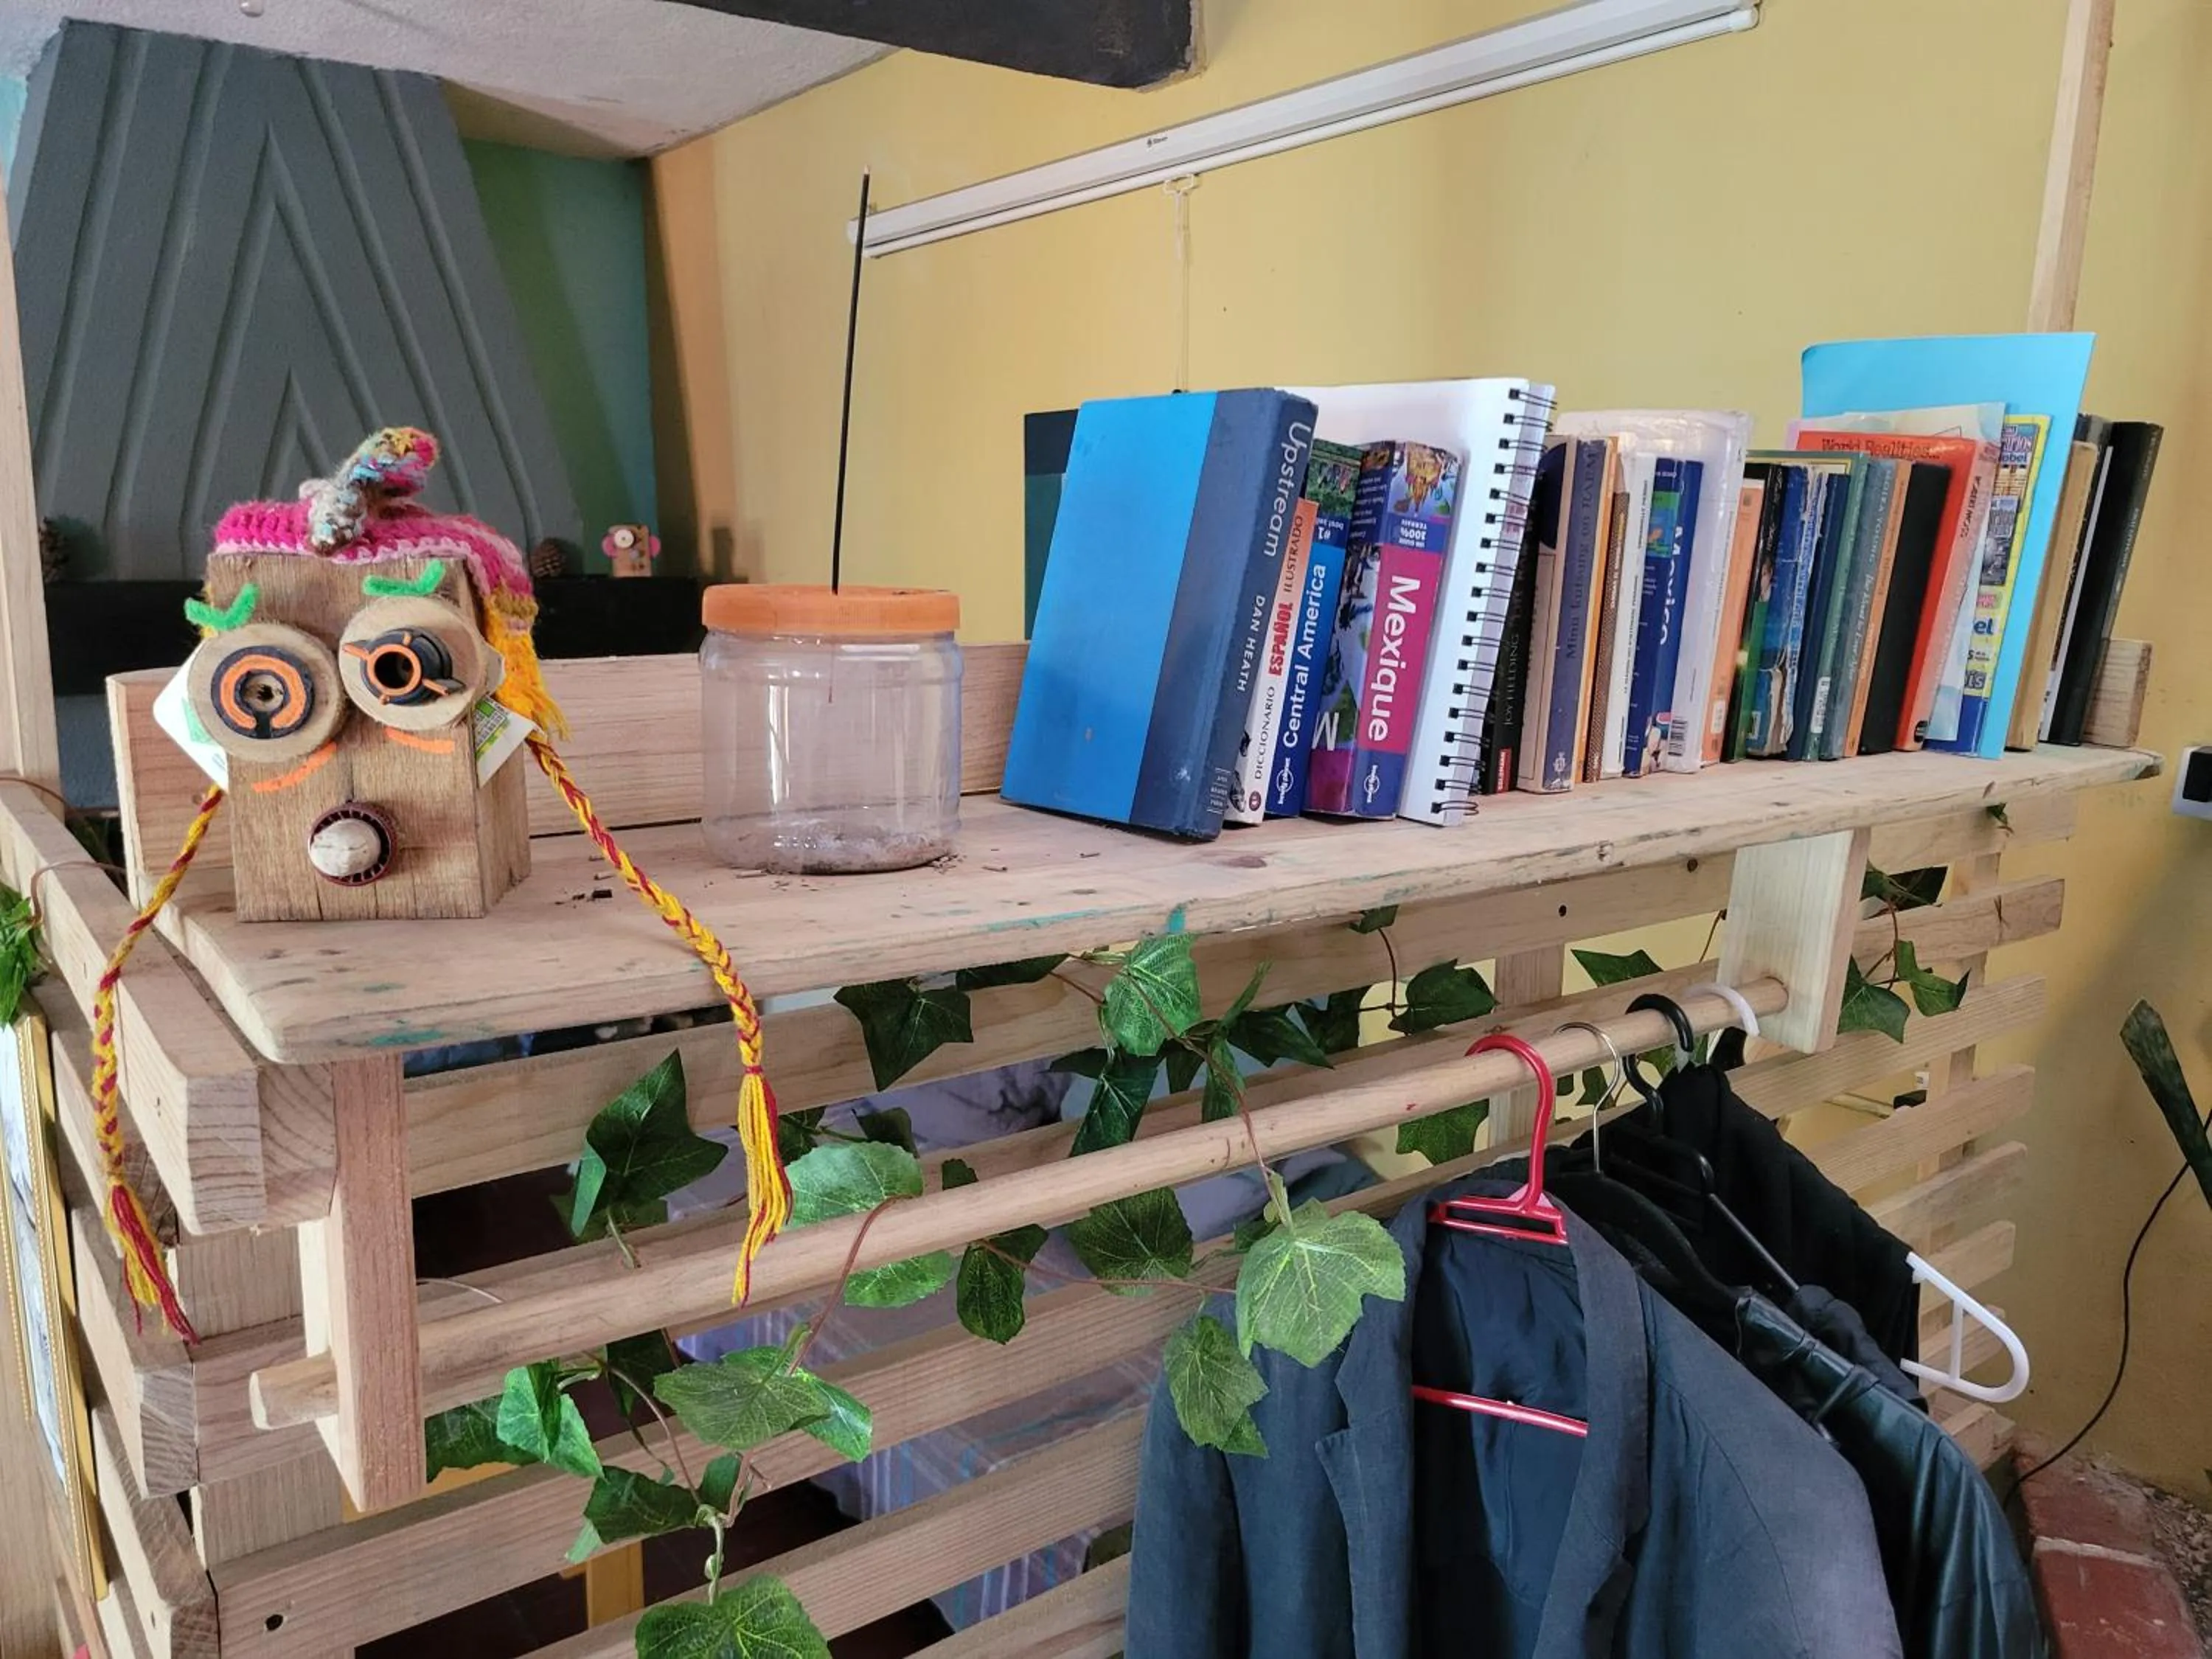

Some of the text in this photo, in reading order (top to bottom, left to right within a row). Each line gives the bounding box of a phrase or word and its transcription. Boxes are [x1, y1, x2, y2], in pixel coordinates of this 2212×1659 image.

[1263, 421, 1312, 557] Upstream
[1317, 526, 1332, 540] #1
[1400, 527, 1427, 540] 100%
[1237, 595, 1266, 692] DAN HEATH
[1255, 515, 1303, 779] DICCIONARIO ESPAÑOL ILUSTRADO
[1282, 563, 1326, 747] Central America
[1368, 575, 1421, 742] Mexique
